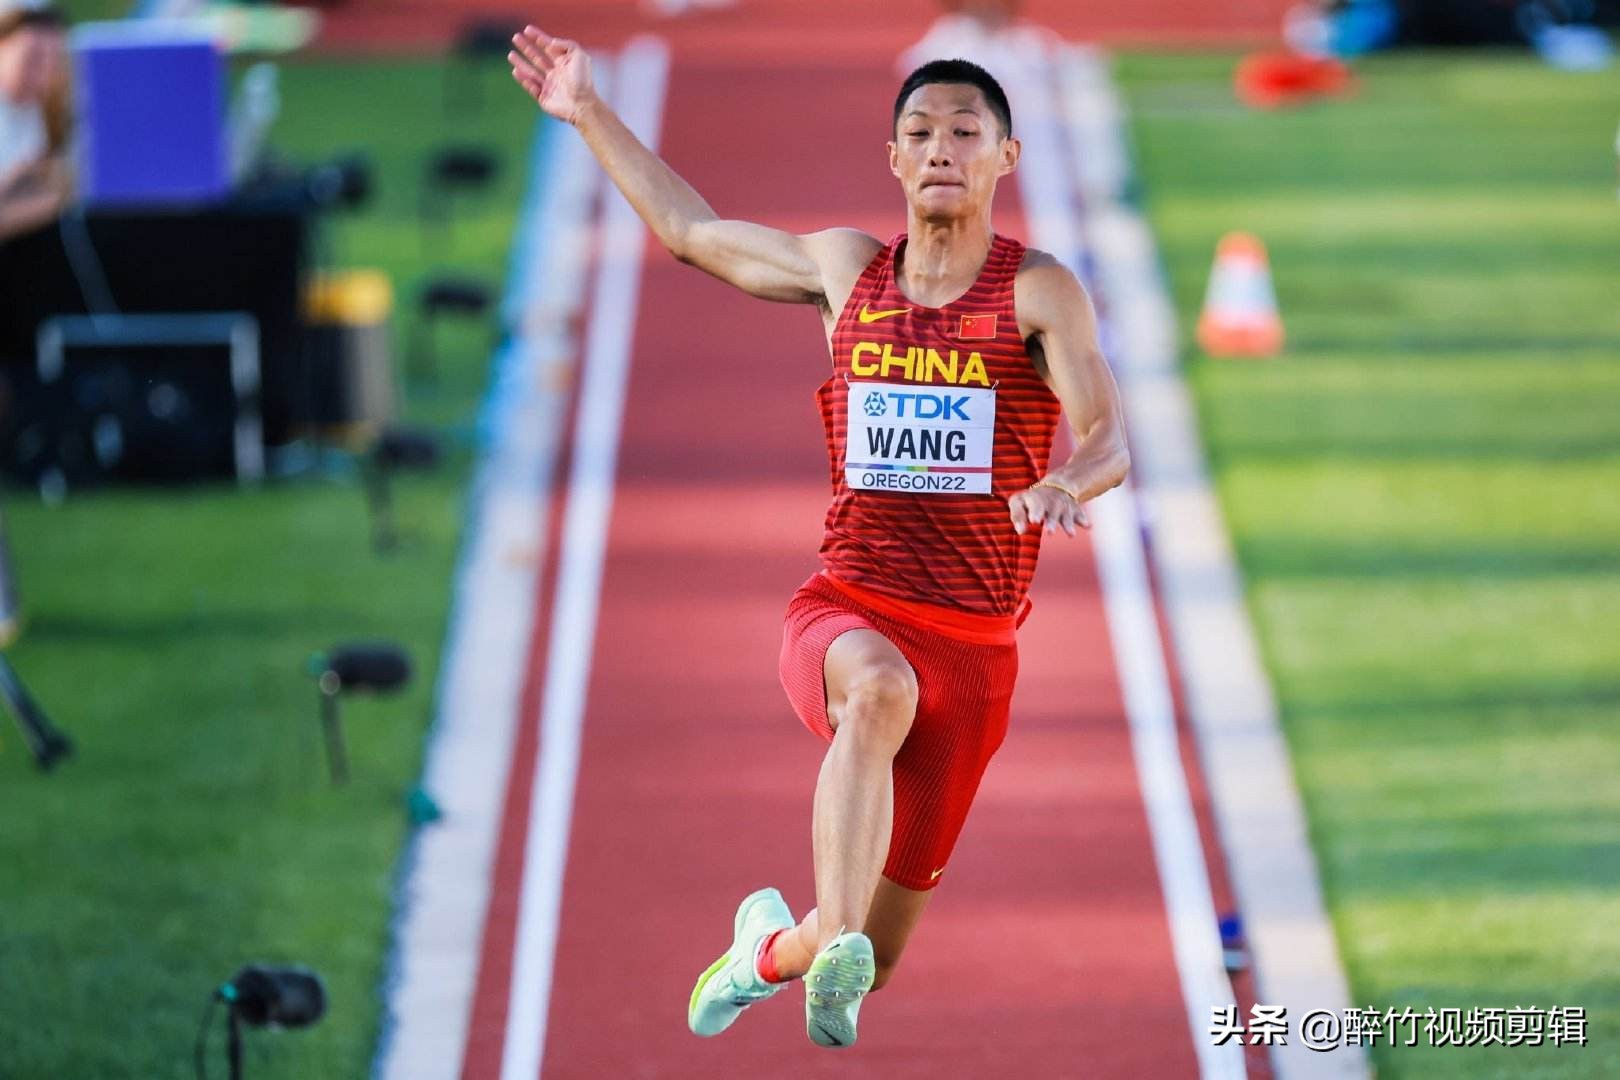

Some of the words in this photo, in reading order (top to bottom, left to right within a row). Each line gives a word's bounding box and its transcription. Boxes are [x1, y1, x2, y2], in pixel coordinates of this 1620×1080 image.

[851, 342, 990, 387] CHINA
[888, 393, 971, 421] TDK
[867, 427, 966, 462] WANG
[862, 473, 966, 491] OREGON22
